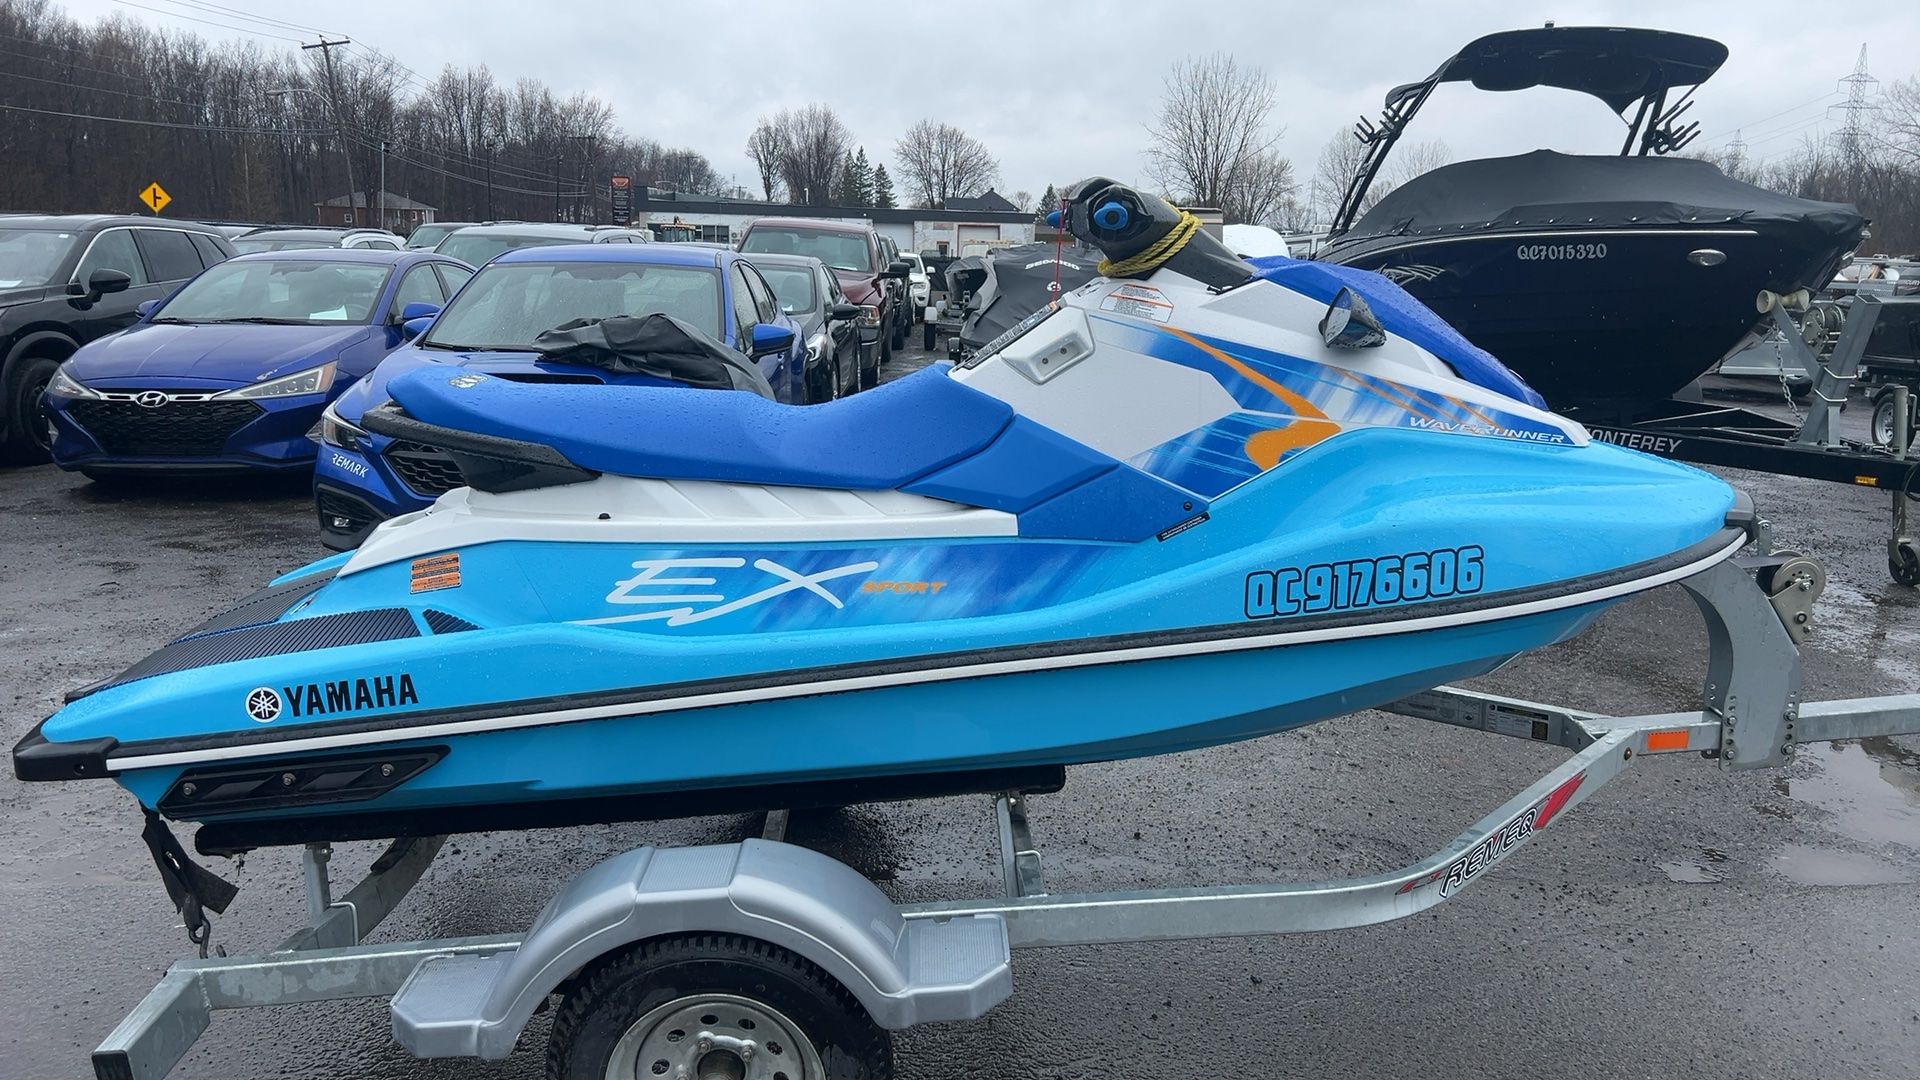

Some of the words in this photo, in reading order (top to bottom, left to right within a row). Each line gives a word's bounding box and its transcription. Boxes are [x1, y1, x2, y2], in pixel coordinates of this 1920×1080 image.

[1516, 244, 1607, 261] QC7015320
[1409, 416, 1565, 444] WAVERUNNER
[1586, 428, 1683, 454] ONTEREY
[332, 453, 369, 478] REMARK
[595, 558, 879, 626] EX
[860, 581, 948, 595] SPORT
[1245, 545, 1484, 619] QC9176606
[283, 673, 419, 717] YAMAHA
[1439, 807, 1538, 898] REMEQ
